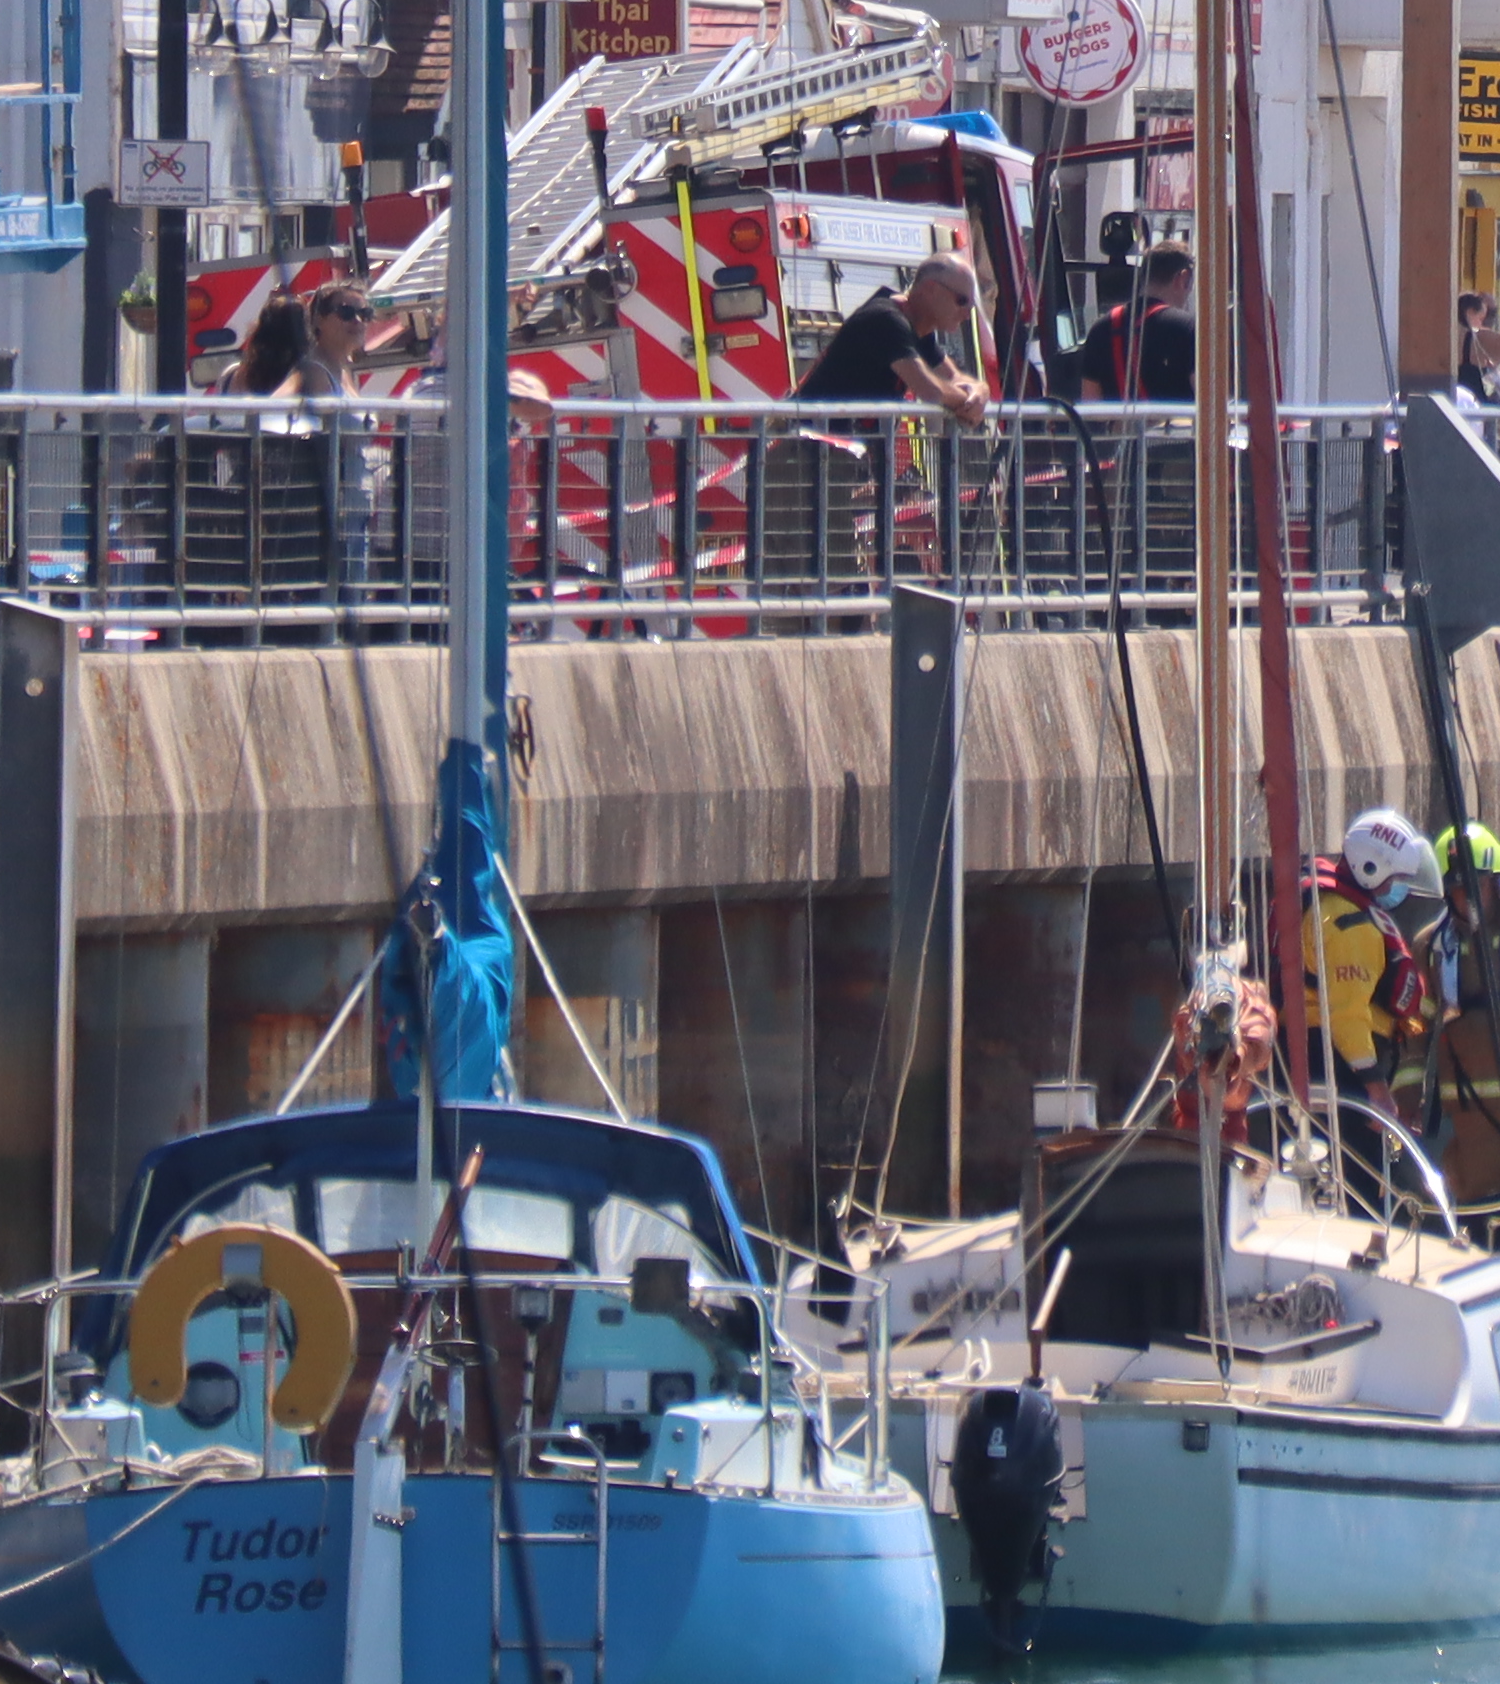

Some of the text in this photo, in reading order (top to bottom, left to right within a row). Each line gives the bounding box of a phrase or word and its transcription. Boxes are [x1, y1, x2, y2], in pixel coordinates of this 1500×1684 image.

[571, 27, 671, 57] Kitchen
[1043, 20, 1112, 50] BURGERS
[1053, 37, 1110, 63] & DOGS
[1459, 103, 1498, 119] ISH
[1477, 134, 1493, 147] IN
[1369, 822, 1407, 853] RNLI
[183, 1518, 330, 1562] Tudor
[194, 1573, 328, 1614] Rose
